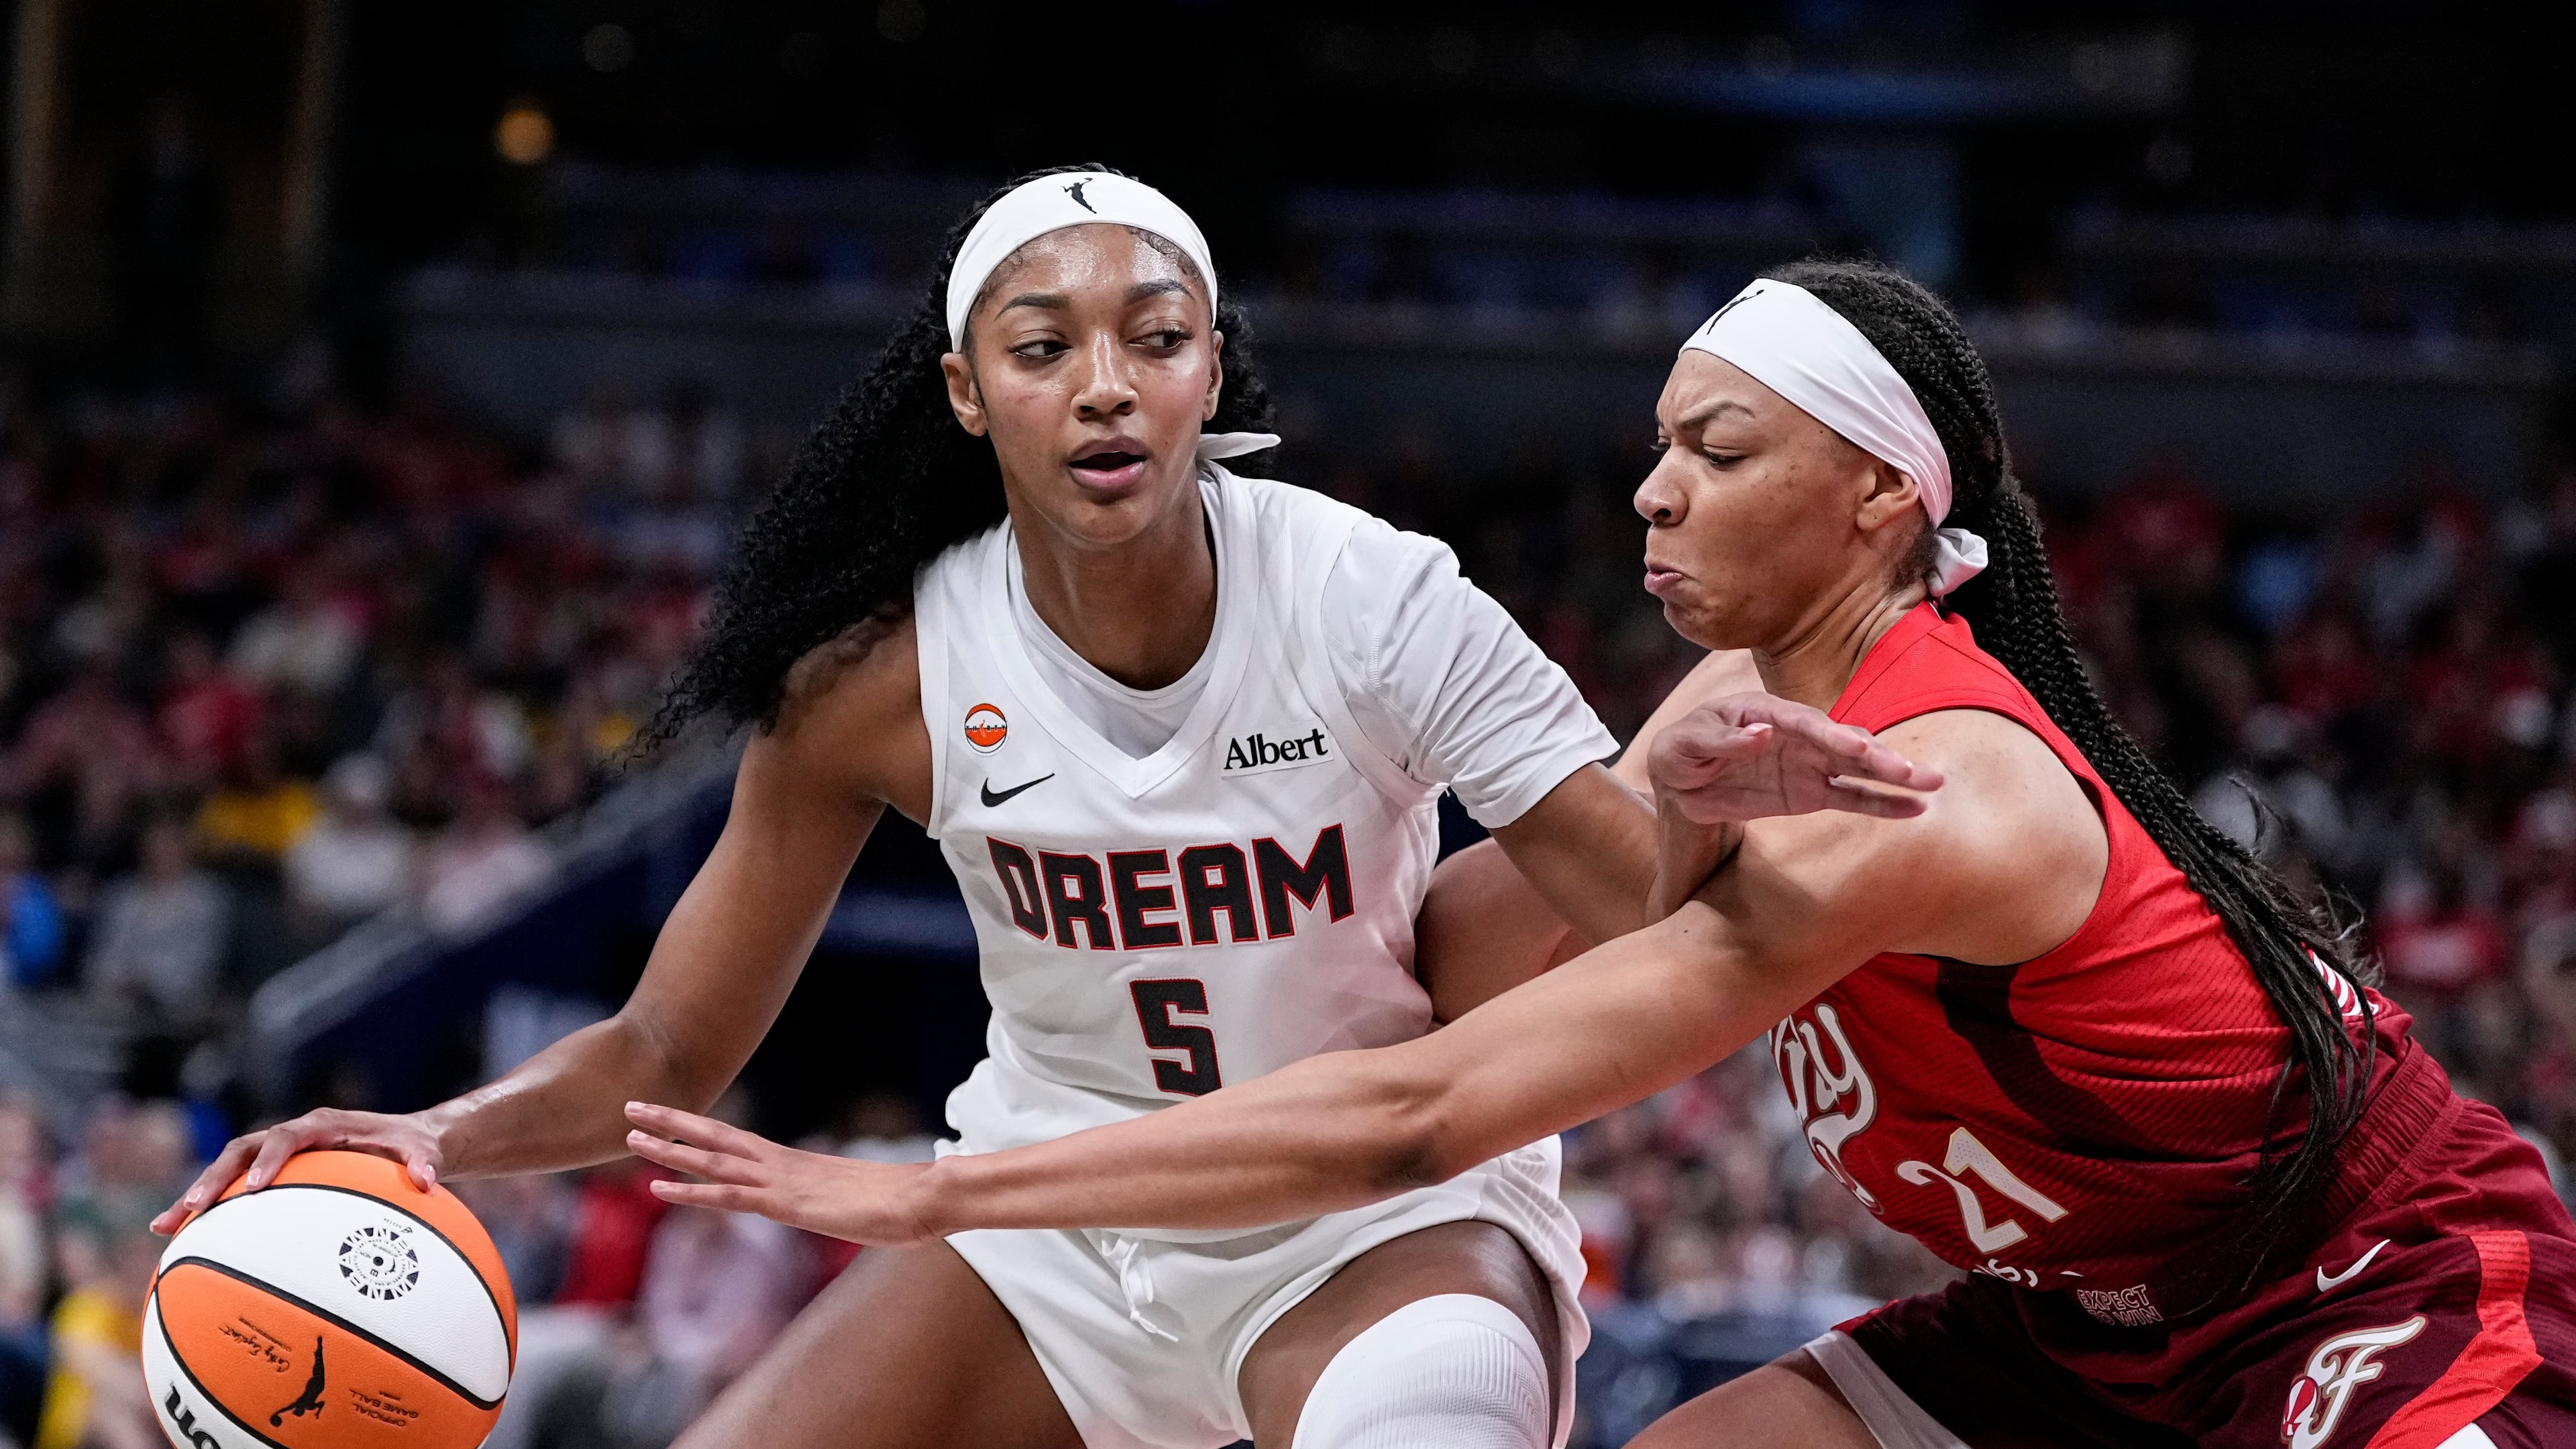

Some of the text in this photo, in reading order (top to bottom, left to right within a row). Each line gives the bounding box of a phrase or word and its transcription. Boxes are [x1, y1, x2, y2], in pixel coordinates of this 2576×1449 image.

[1223, 728, 1328, 770] Albert
[986, 822, 1354, 951] DREAM
[1129, 977, 1223, 1097] 5
[1894, 1126, 2070, 1254] 21
[2077, 1283, 2150, 1311] EXPECT
[2112, 1305, 2165, 1327] WIN
[349, 1389, 382, 1407] BALL
[382, 1402, 419, 1419] GAME
[352, 1403, 407, 1428] OFFICIAL
